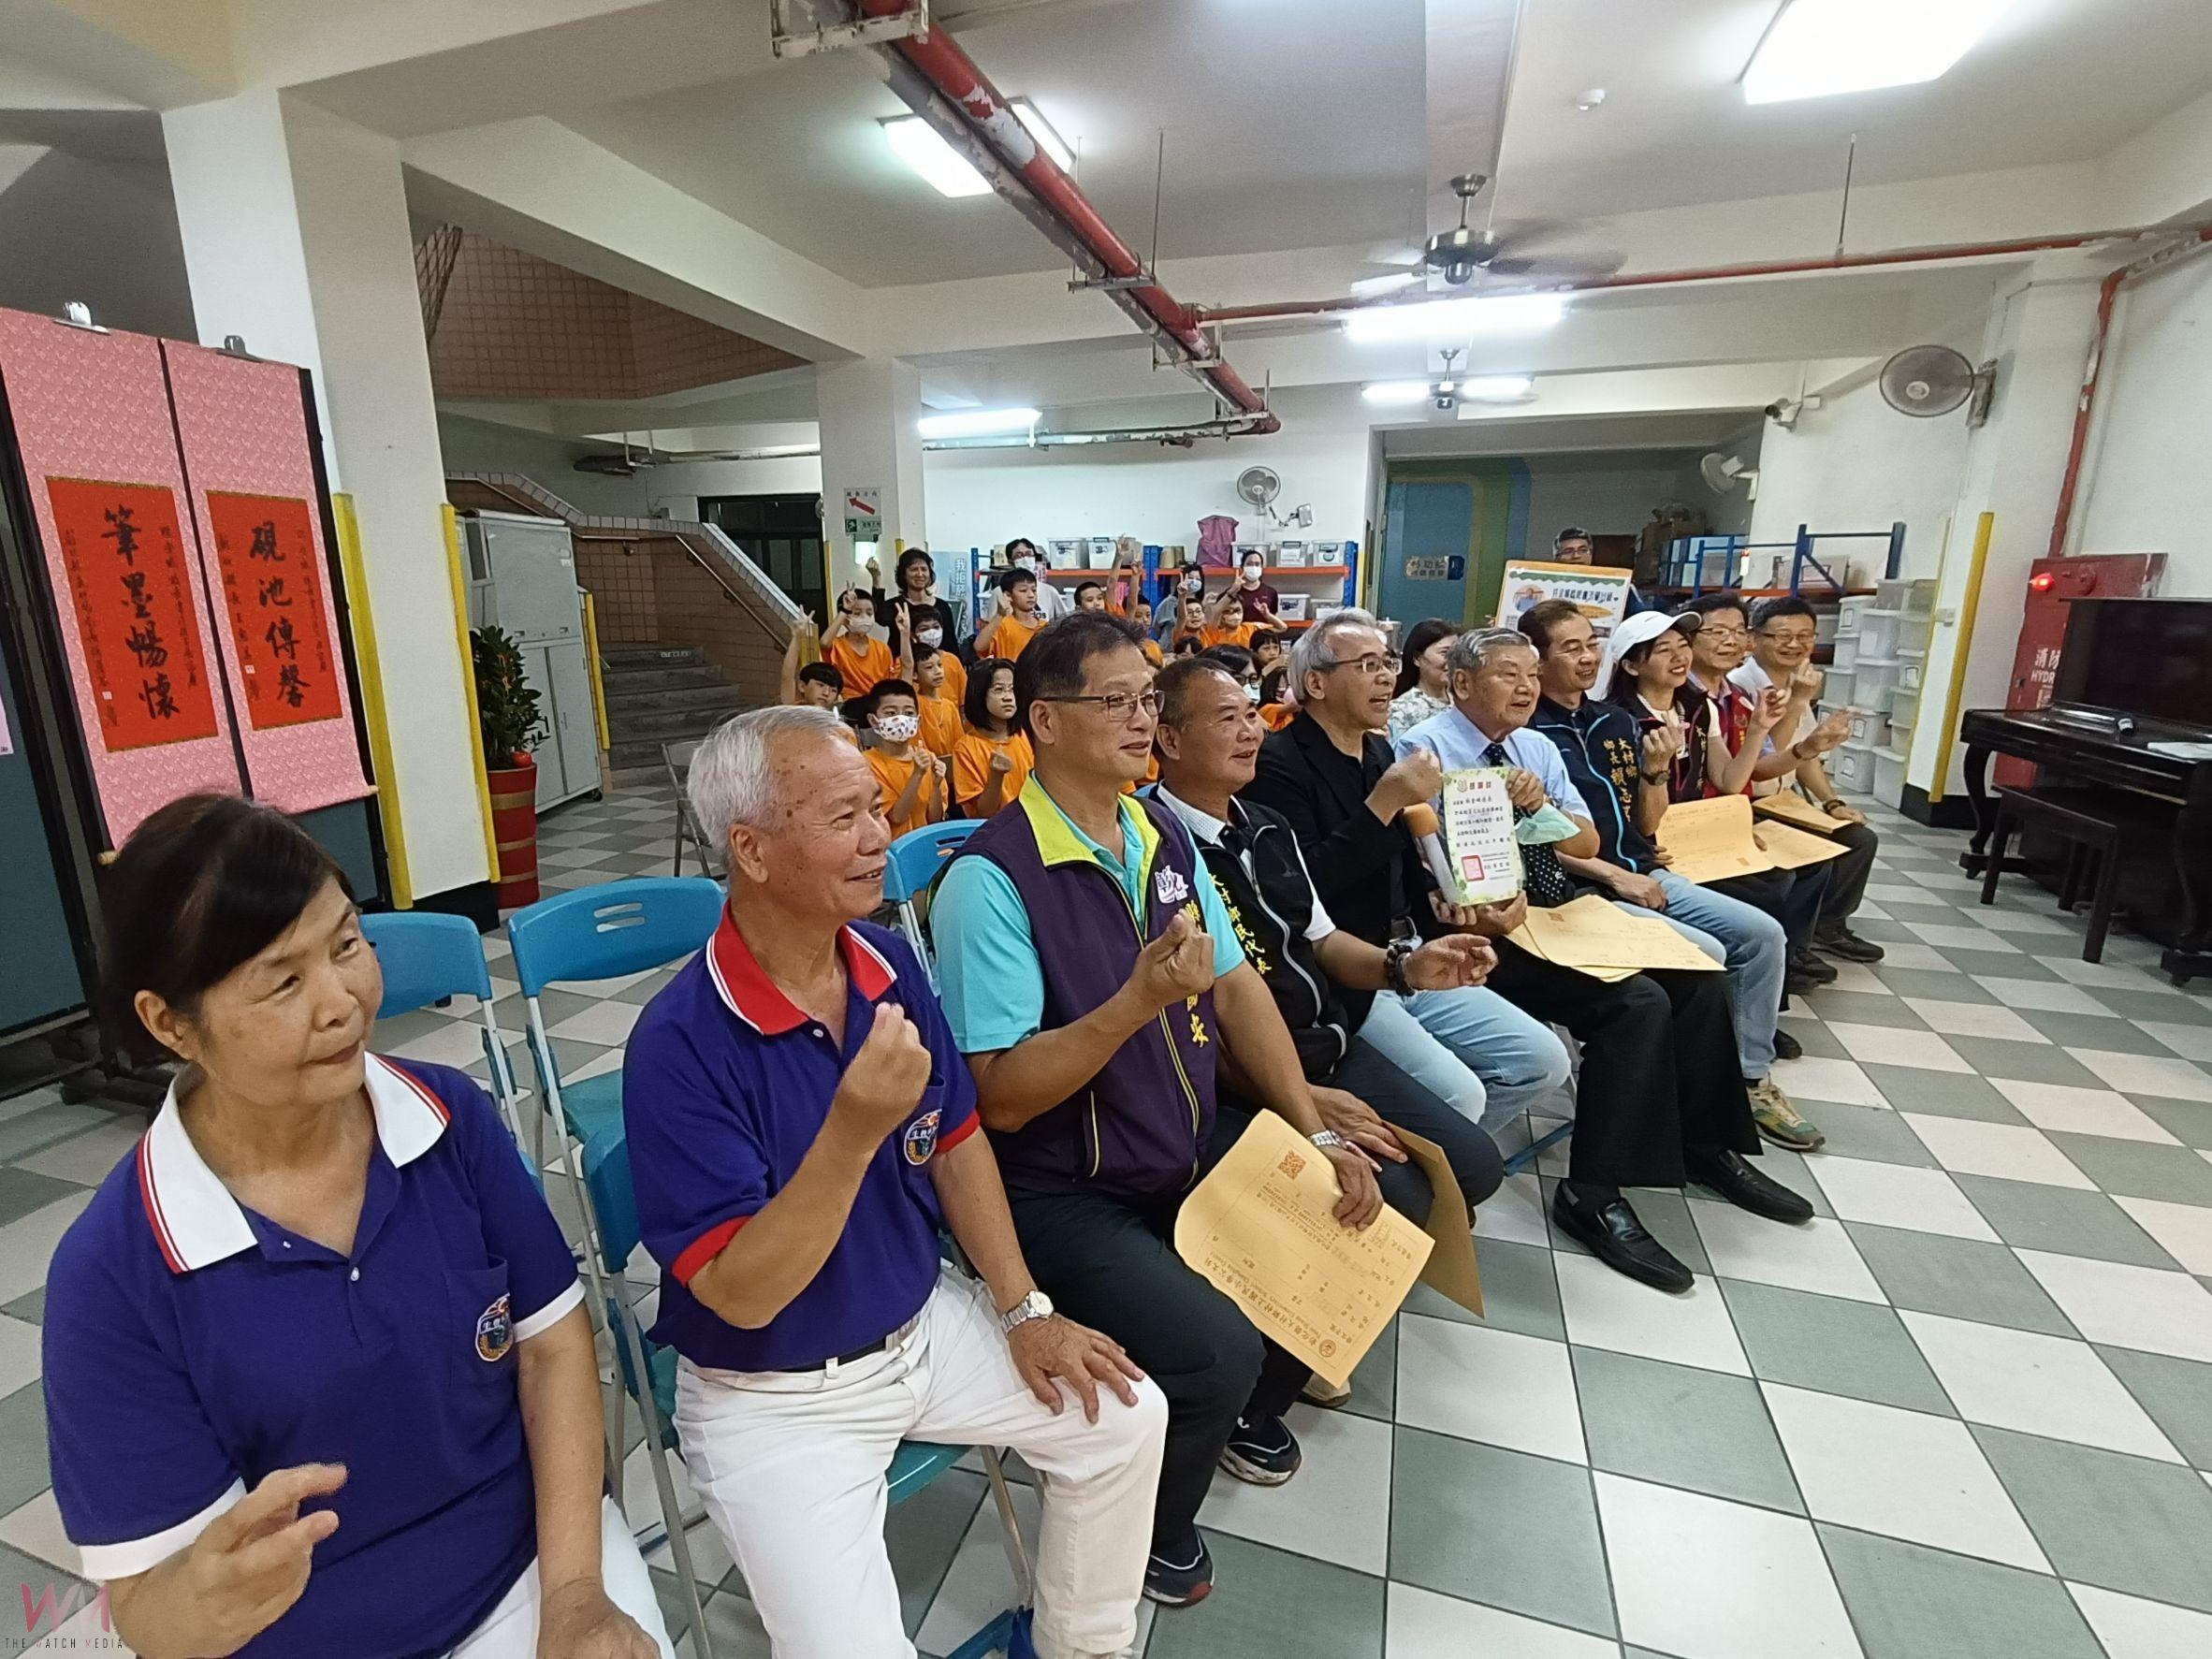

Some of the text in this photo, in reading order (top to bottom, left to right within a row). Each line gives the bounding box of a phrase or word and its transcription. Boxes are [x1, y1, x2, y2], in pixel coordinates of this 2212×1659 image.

[101, 504, 181, 720] 筆墨暢懷
[249, 520, 312, 709] 硯池傳馨
[2034, 648, 2061, 669] 消防
[2030, 669, 2056, 684] HYDR
